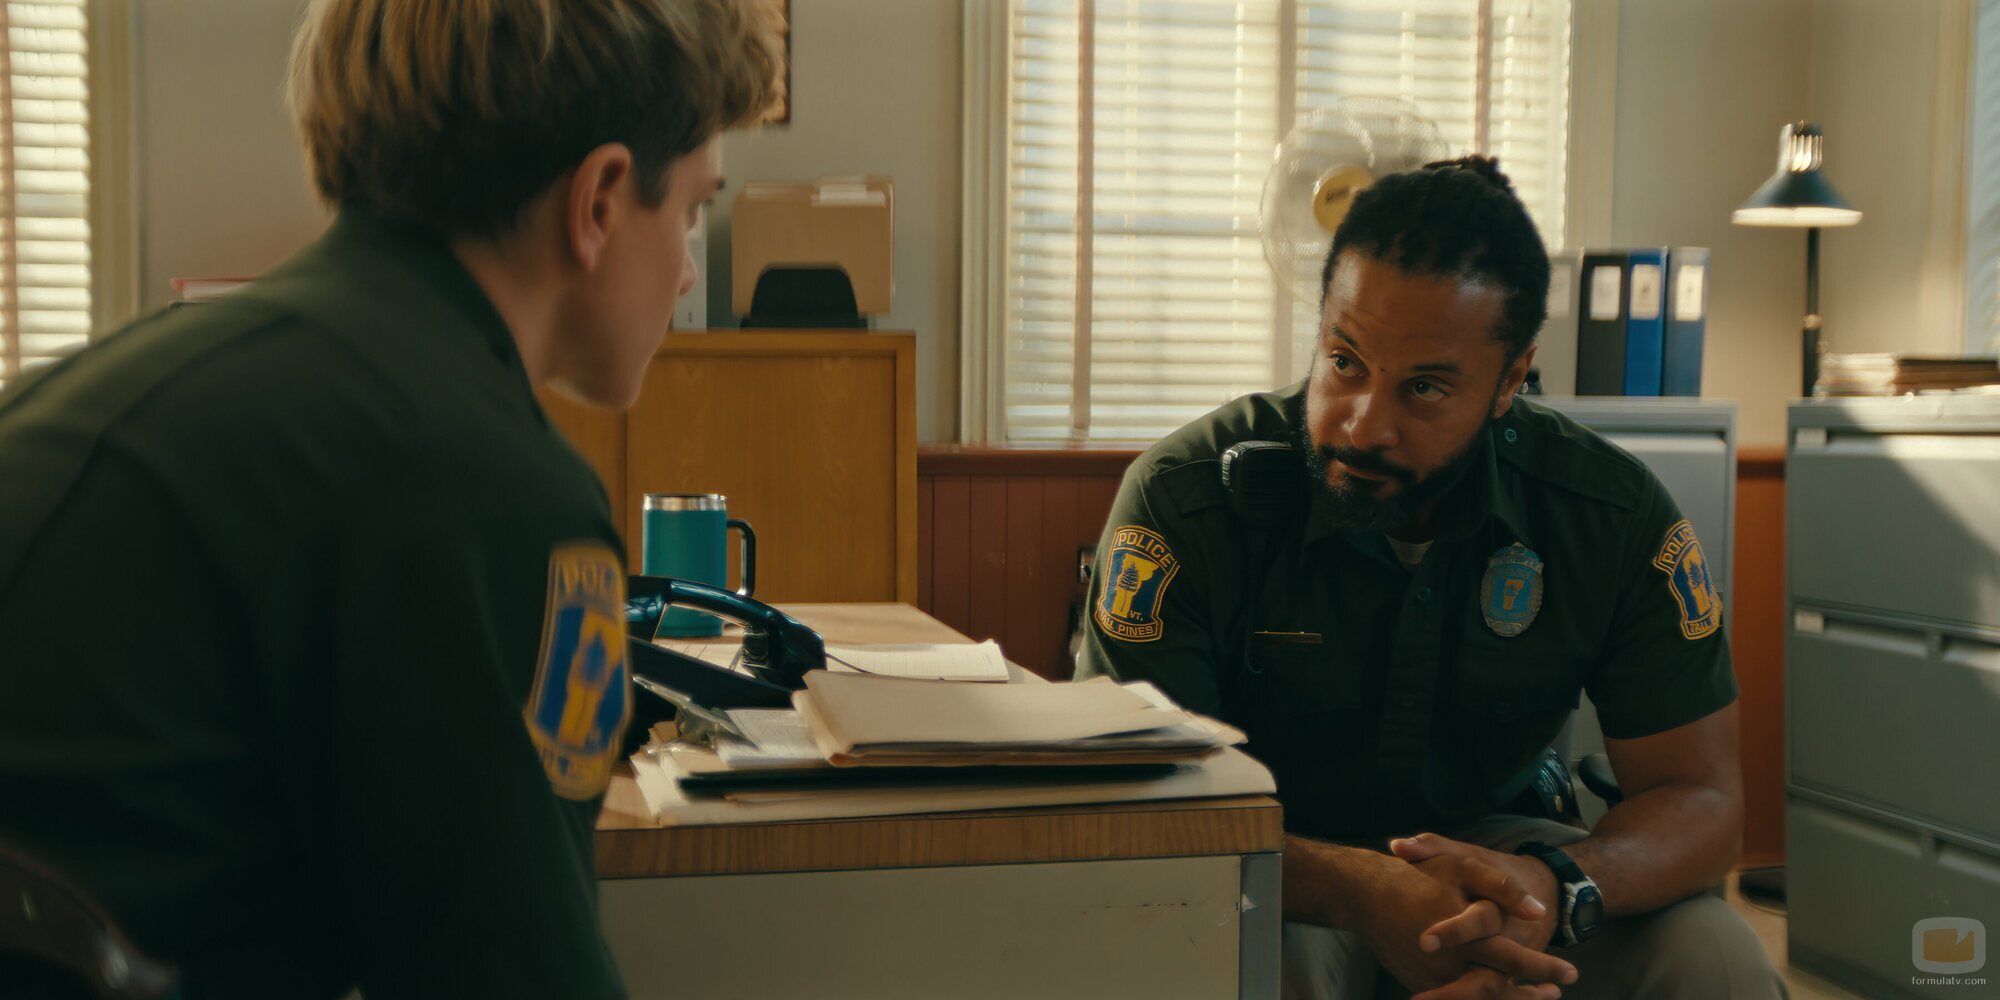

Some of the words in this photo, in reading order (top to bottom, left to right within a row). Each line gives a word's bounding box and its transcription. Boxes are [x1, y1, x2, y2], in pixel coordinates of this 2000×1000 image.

[1118, 532, 1175, 568] POLICE
[1130, 610, 1144, 621] VT.
[1118, 623, 1154, 636] PINES
